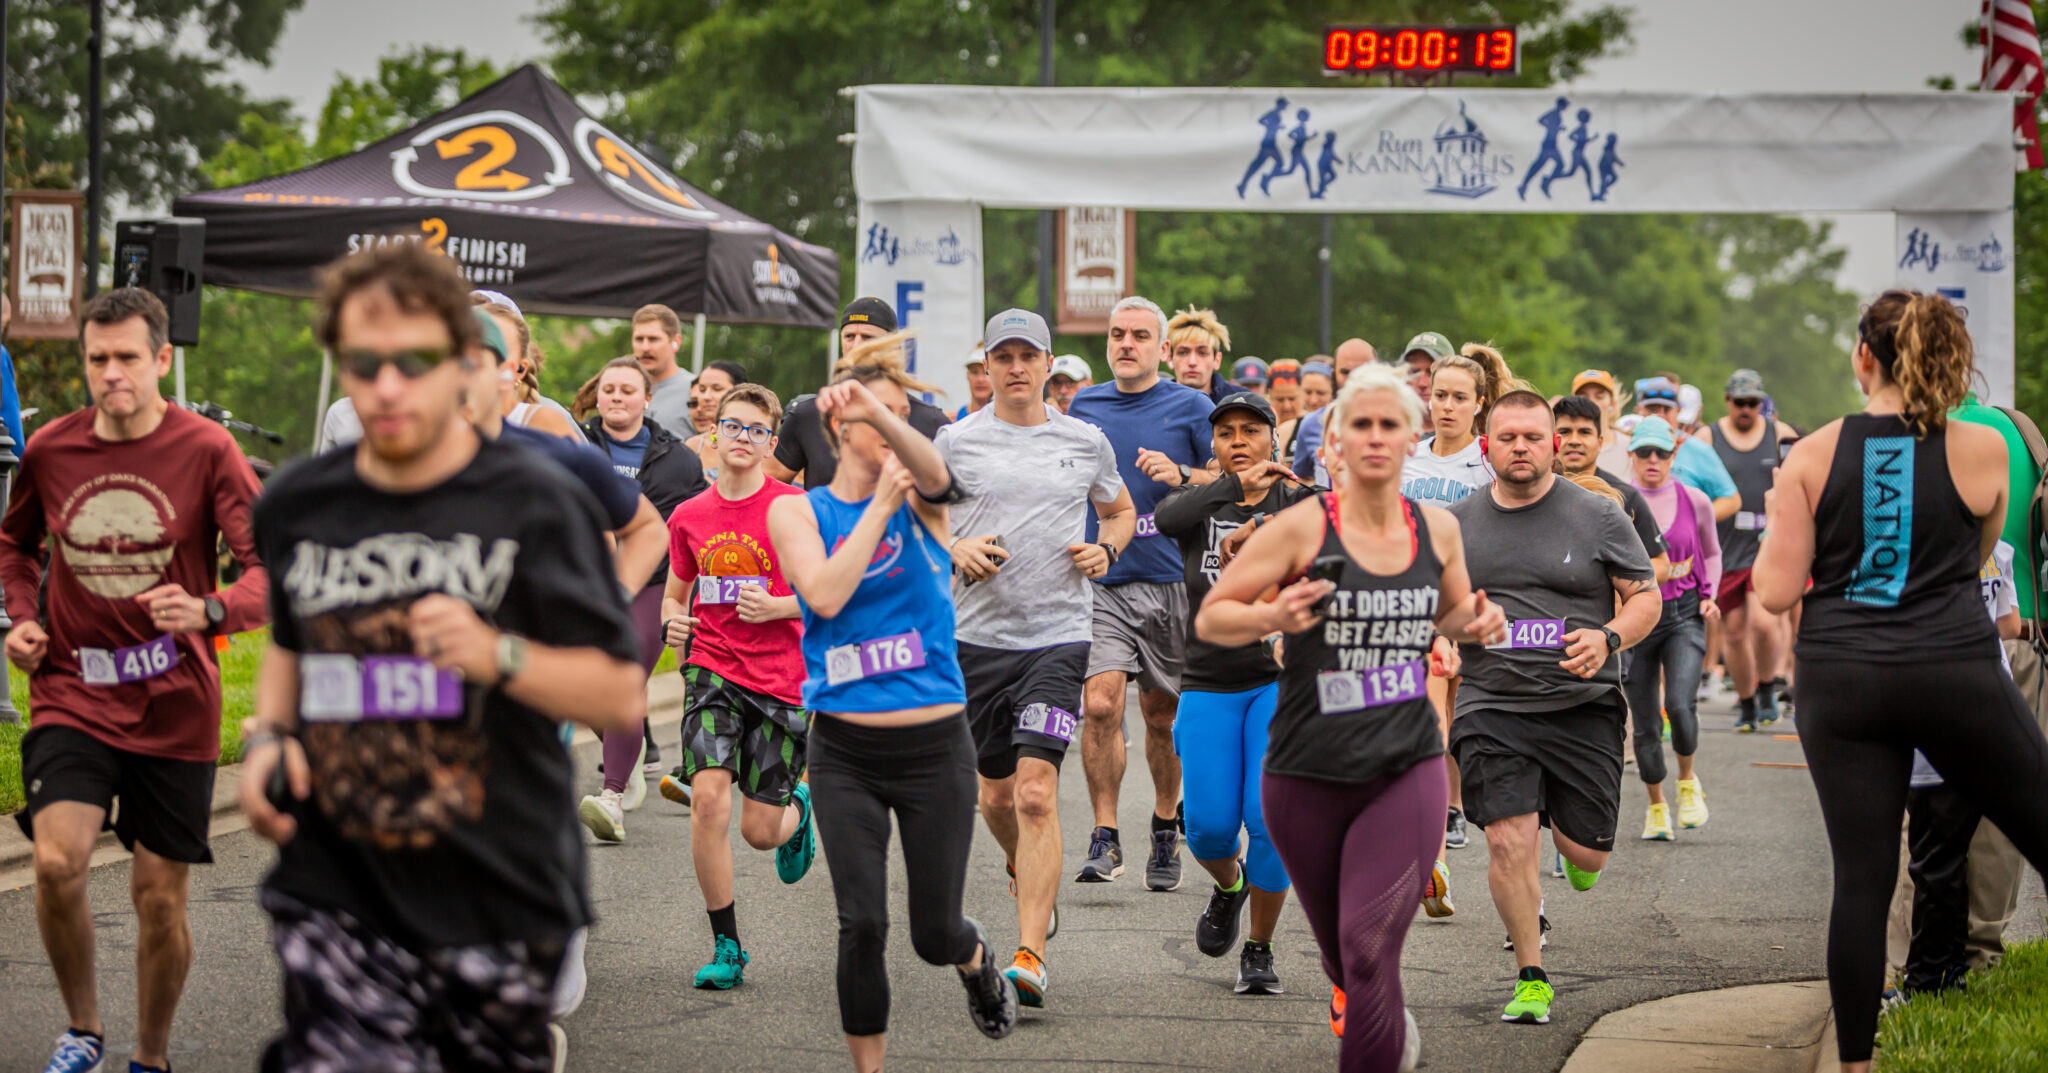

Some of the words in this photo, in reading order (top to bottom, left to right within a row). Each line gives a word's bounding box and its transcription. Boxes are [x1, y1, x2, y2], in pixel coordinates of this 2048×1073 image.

[1378, 130, 1422, 152] Run
[436, 126, 531, 191] 2
[1347, 150, 1514, 182] KANNAPOLIS
[447, 236, 526, 268] FINISH
[1136, 516, 1158, 535] 03
[1866, 448, 1903, 597] NATION
[742, 533, 772, 572] TACO
[1357, 585, 1440, 618] DOESN'T
[1325, 620, 1368, 646] GET
[1516, 622, 1558, 645] 402
[124, 642, 169, 678] 416
[867, 638, 913, 671] 176
[1338, 648, 1381, 672] YOU
[373, 661, 438, 713] 151
[1369, 665, 1417, 701] 134
